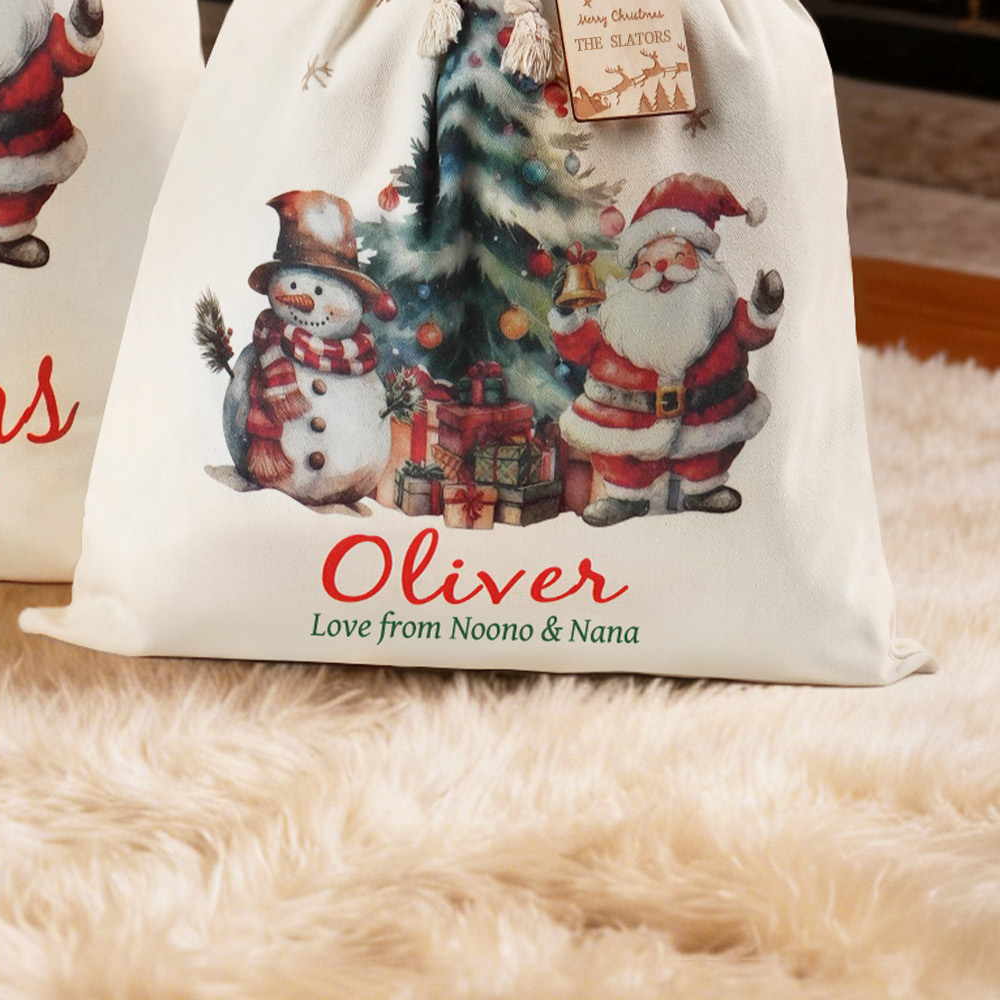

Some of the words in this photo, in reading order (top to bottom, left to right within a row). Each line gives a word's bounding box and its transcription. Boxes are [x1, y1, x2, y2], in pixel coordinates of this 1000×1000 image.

[577, 13, 608, 29] Merry
[611, 7, 665, 22] Christmas
[574, 36, 604, 52] THE
[610, 29, 672, 49] SLATORS
[321, 527, 630, 606] Oliver
[310, 612, 372, 638] Love
[376, 610, 441, 646] from
[449, 616, 534, 642] Noono
[540, 615, 564, 643] &
[568, 619, 640, 644] Nana
